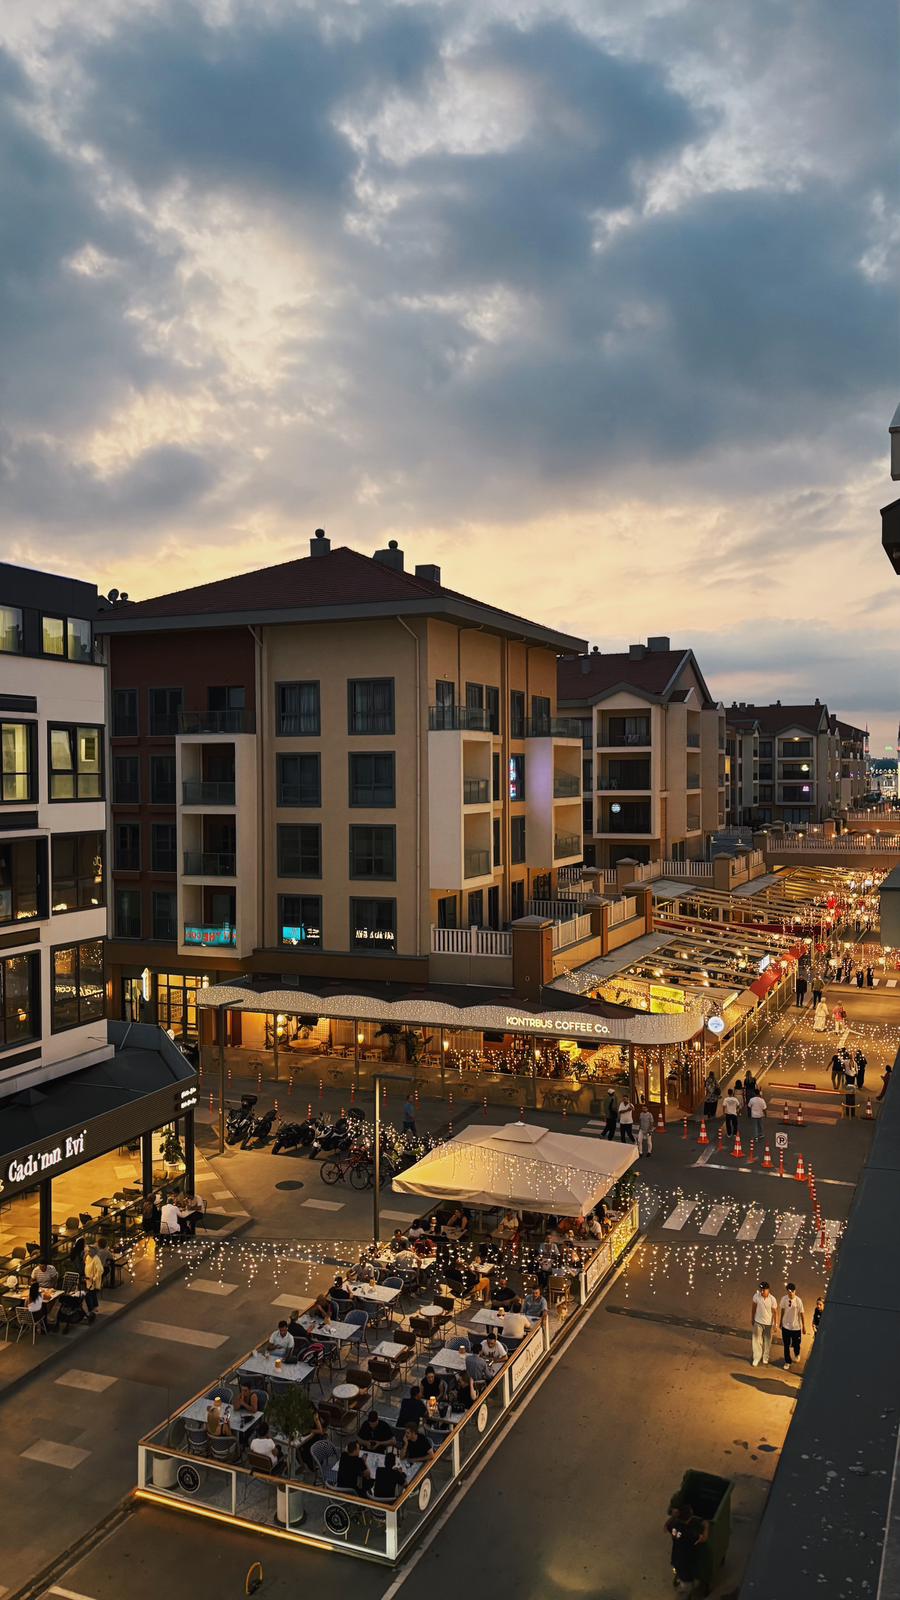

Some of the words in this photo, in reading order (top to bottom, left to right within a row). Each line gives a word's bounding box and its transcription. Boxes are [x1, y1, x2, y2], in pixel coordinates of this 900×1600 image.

[506, 1016, 552, 1028] KONTRBUS
[555, 1021, 592, 1032] COFFEE
[594, 1024, 610, 1033] Co.
[65, 1133, 84, 1157] Evi
